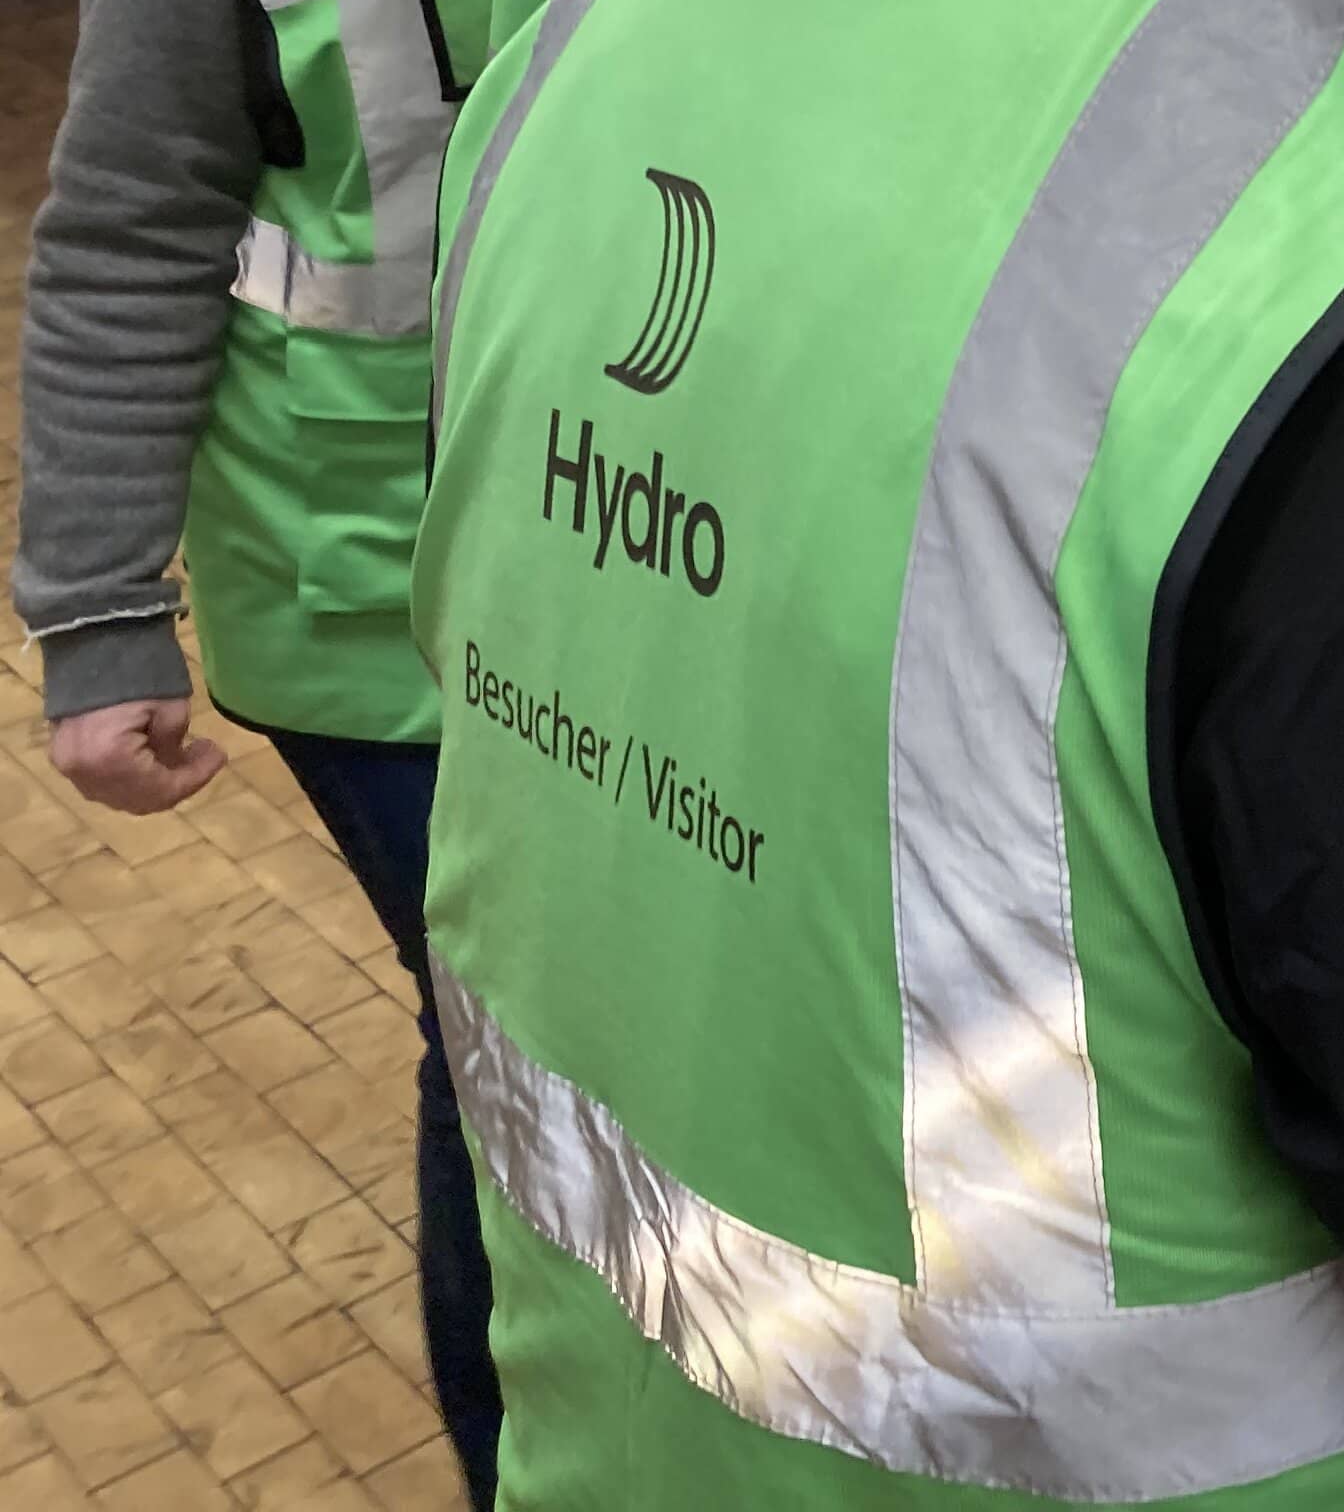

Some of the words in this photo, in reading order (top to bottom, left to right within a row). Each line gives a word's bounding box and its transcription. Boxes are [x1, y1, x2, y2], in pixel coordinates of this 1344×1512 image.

[543, 408, 726, 599] Hydro
[465, 639, 612, 787] Besucher
[614, 735, 634, 805] /
[642, 742, 766, 885] Visitor
